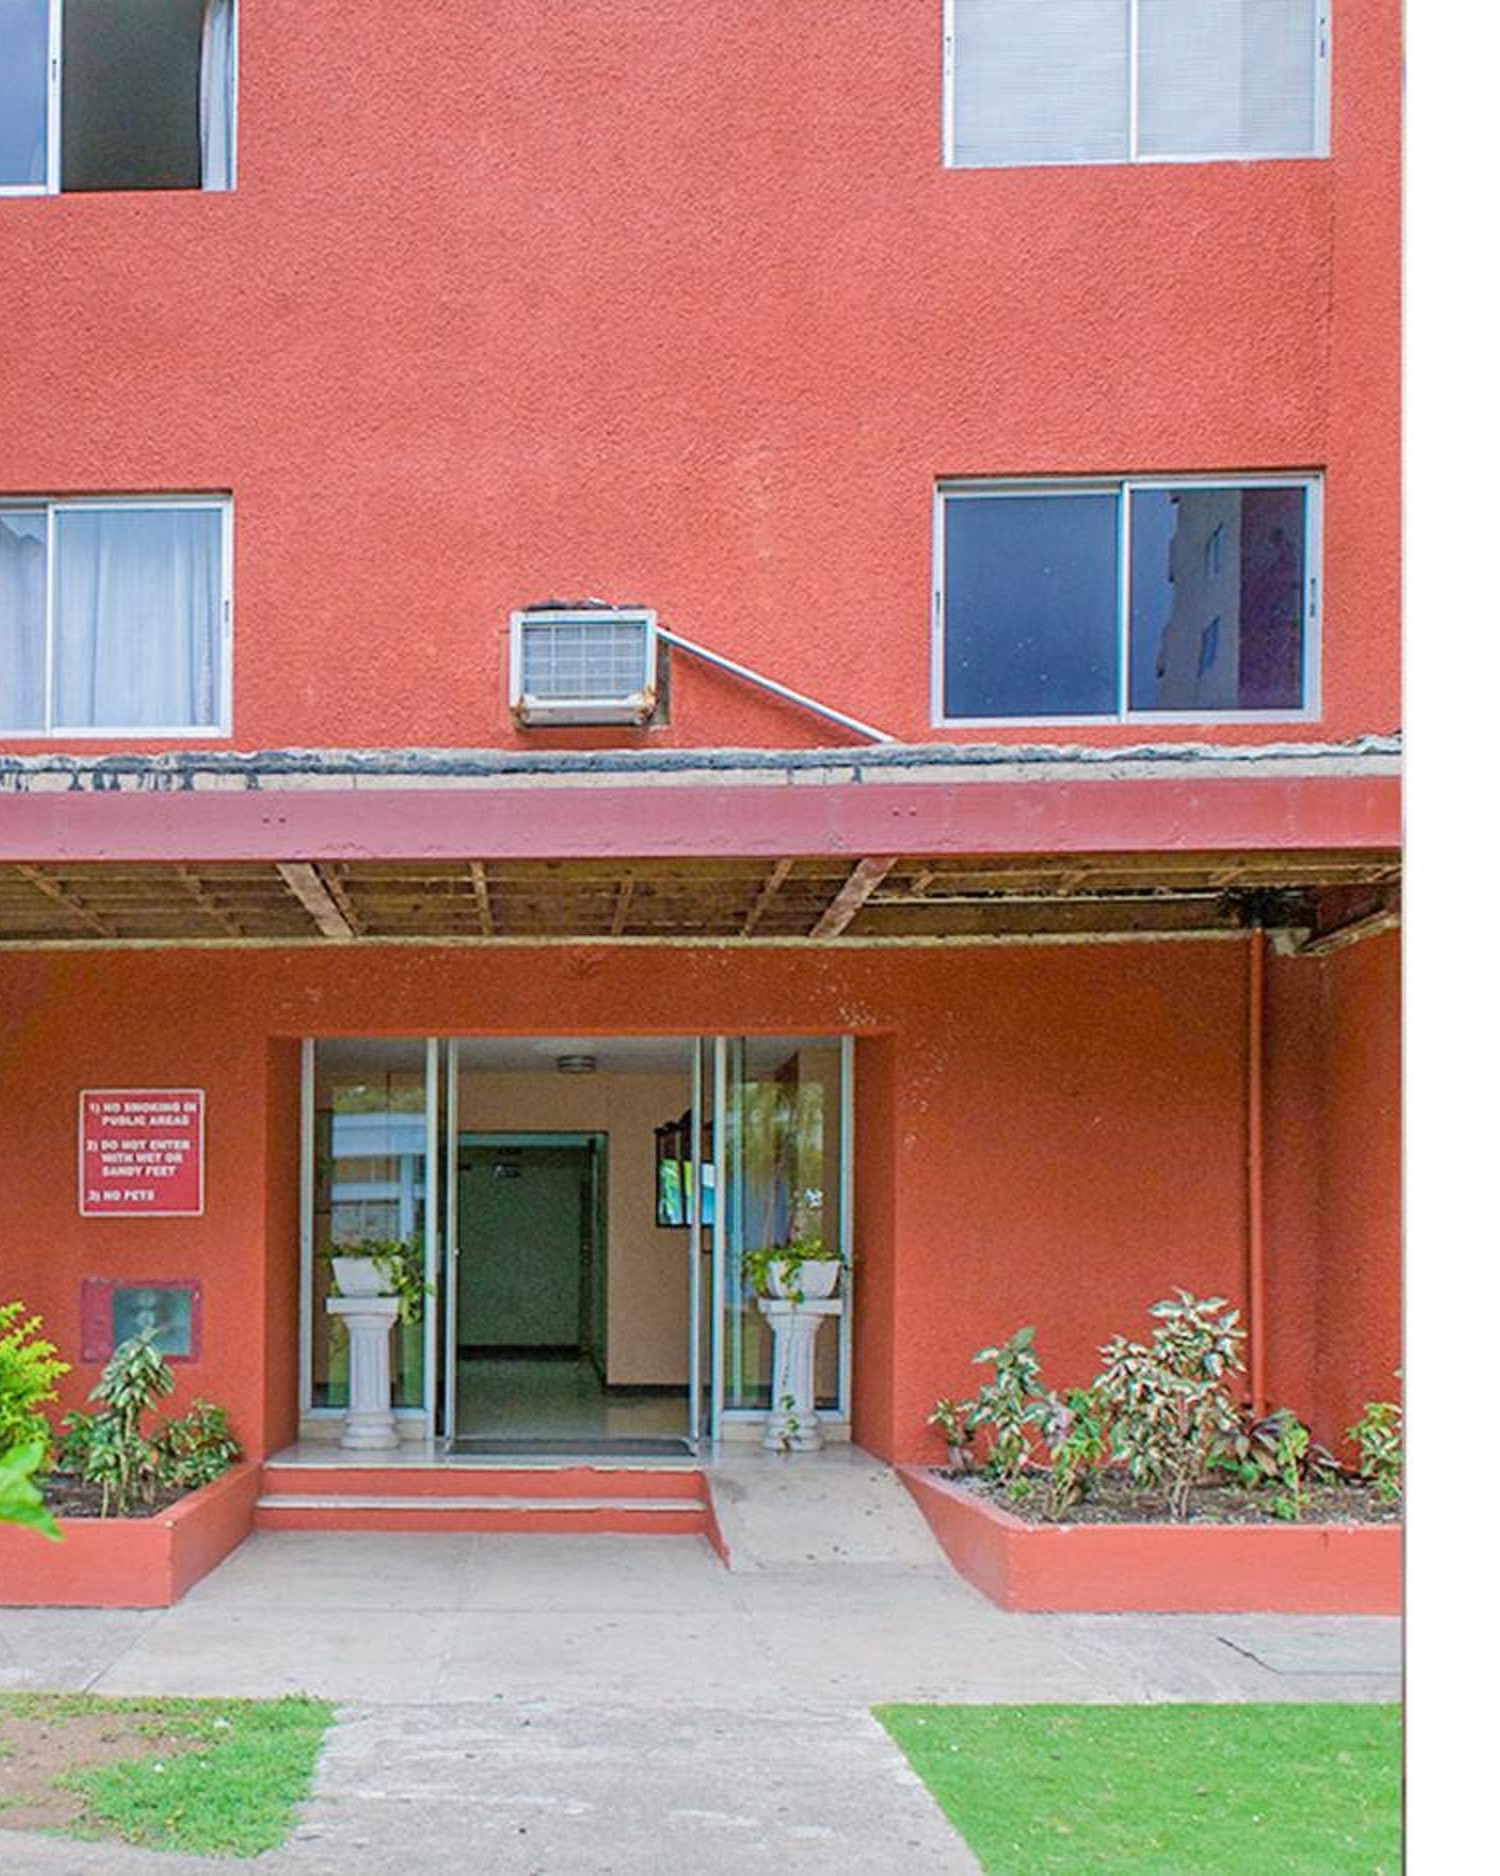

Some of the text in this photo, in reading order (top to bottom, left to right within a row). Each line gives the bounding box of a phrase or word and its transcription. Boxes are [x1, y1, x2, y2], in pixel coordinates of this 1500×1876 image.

[102, 1102, 120, 1112] NO
[124, 1102, 180, 1112] SMOKING
[183, 1102, 197, 1112] IN
[101, 1115, 190, 1125] PUBLIC AREAS
[101, 1139, 119, 1150] DO
[121, 1139, 146, 1150] NOT
[149, 1140, 190, 1150] ENTER
[101, 1152, 183, 1163] WITH WET OR
[102, 1166, 176, 1176] SANDY FEET
[102, 1190, 120, 1200] NO
[124, 1190, 155, 1200] PETS
